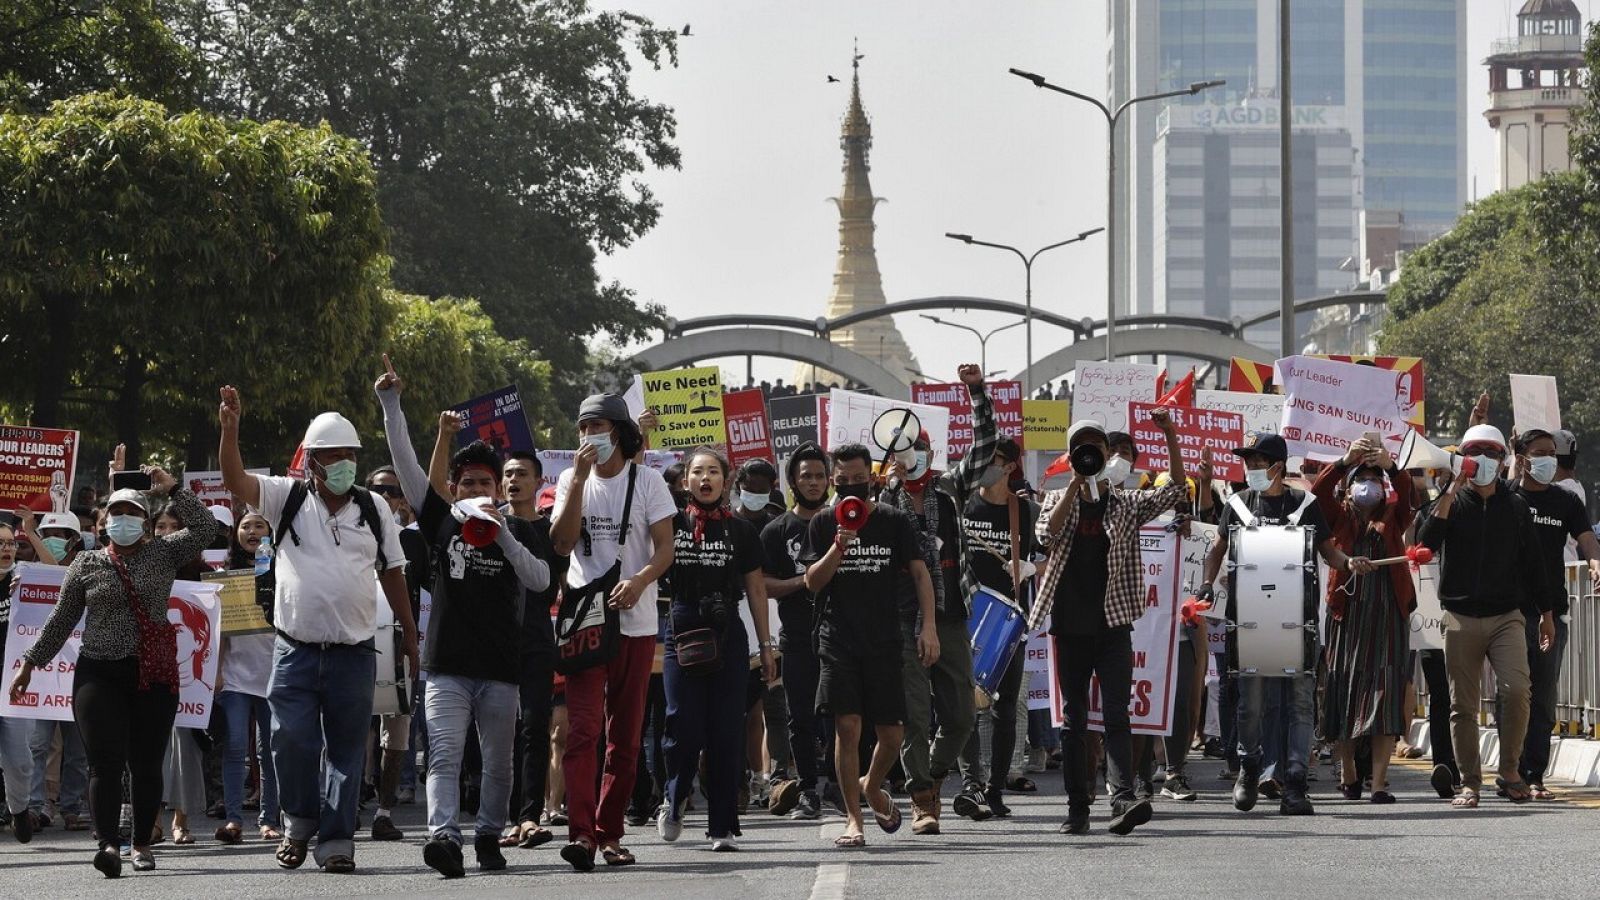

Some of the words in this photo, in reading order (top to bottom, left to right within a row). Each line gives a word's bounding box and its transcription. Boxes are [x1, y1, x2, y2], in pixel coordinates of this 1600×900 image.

[1264, 107, 1327, 124] BNK
[646, 380, 671, 392] We
[676, 374, 718, 389] Need
[1306, 372, 1343, 387] Leader
[504, 392, 519, 403] DAY
[669, 421, 695, 431] Save
[699, 418, 720, 427] Our
[773, 416, 817, 430] RELEASE
[1318, 404, 1343, 418] SAN
[1347, 410, 1371, 425] SUU
[1374, 418, 1393, 431] KYI
[728, 416, 766, 444] Civil
[662, 434, 714, 447] Situation
[775, 434, 800, 448] OUR
[1134, 430, 1201, 446] SUPORT
[20, 442, 65, 456] LEADERS
[1148, 458, 1230, 477] MOEMNT
[10, 484, 48, 494] AGAINST
[590, 515, 613, 523] Drum
[961, 518, 993, 530] Drum
[1150, 563, 1162, 576] OF
